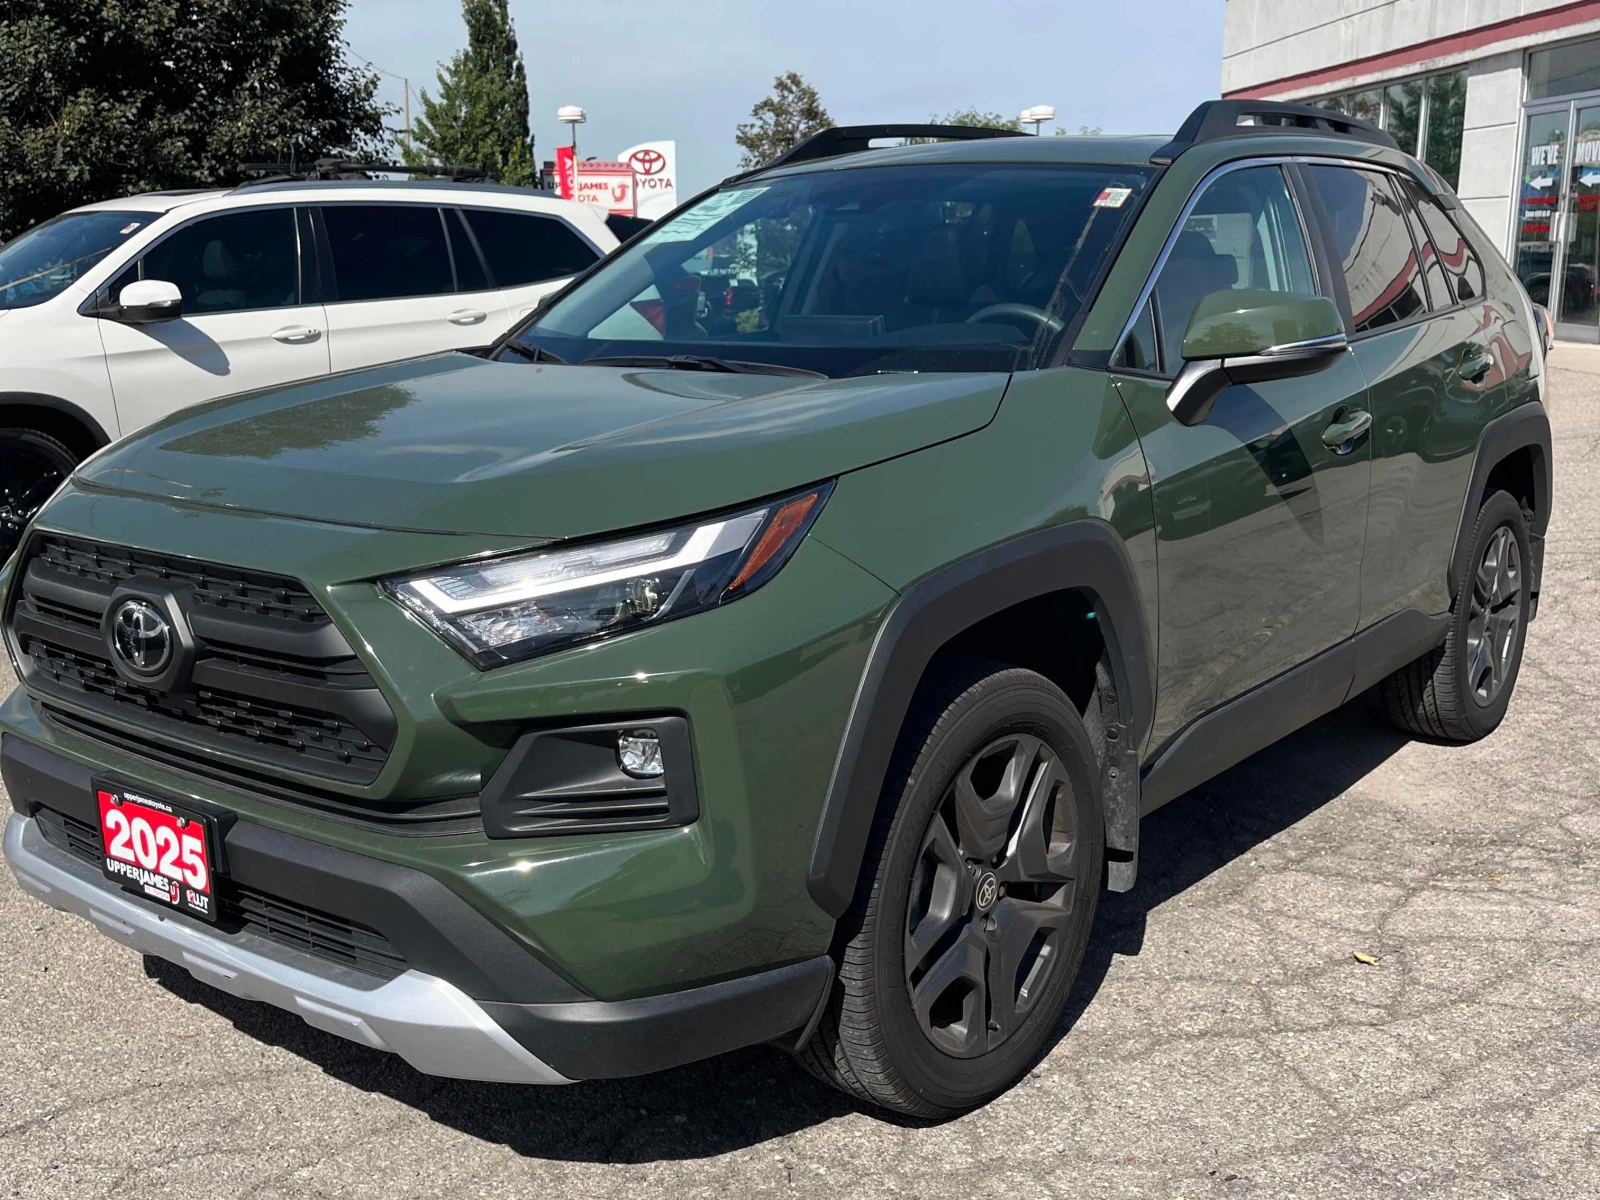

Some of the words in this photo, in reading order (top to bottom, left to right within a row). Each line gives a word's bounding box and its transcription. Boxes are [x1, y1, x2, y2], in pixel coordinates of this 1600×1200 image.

[1531, 144, 1559, 166] WE'VE
[1575, 140, 1600, 163] MOV
[635, 178, 674, 189] YOTA
[105, 808, 207, 890] 2025
